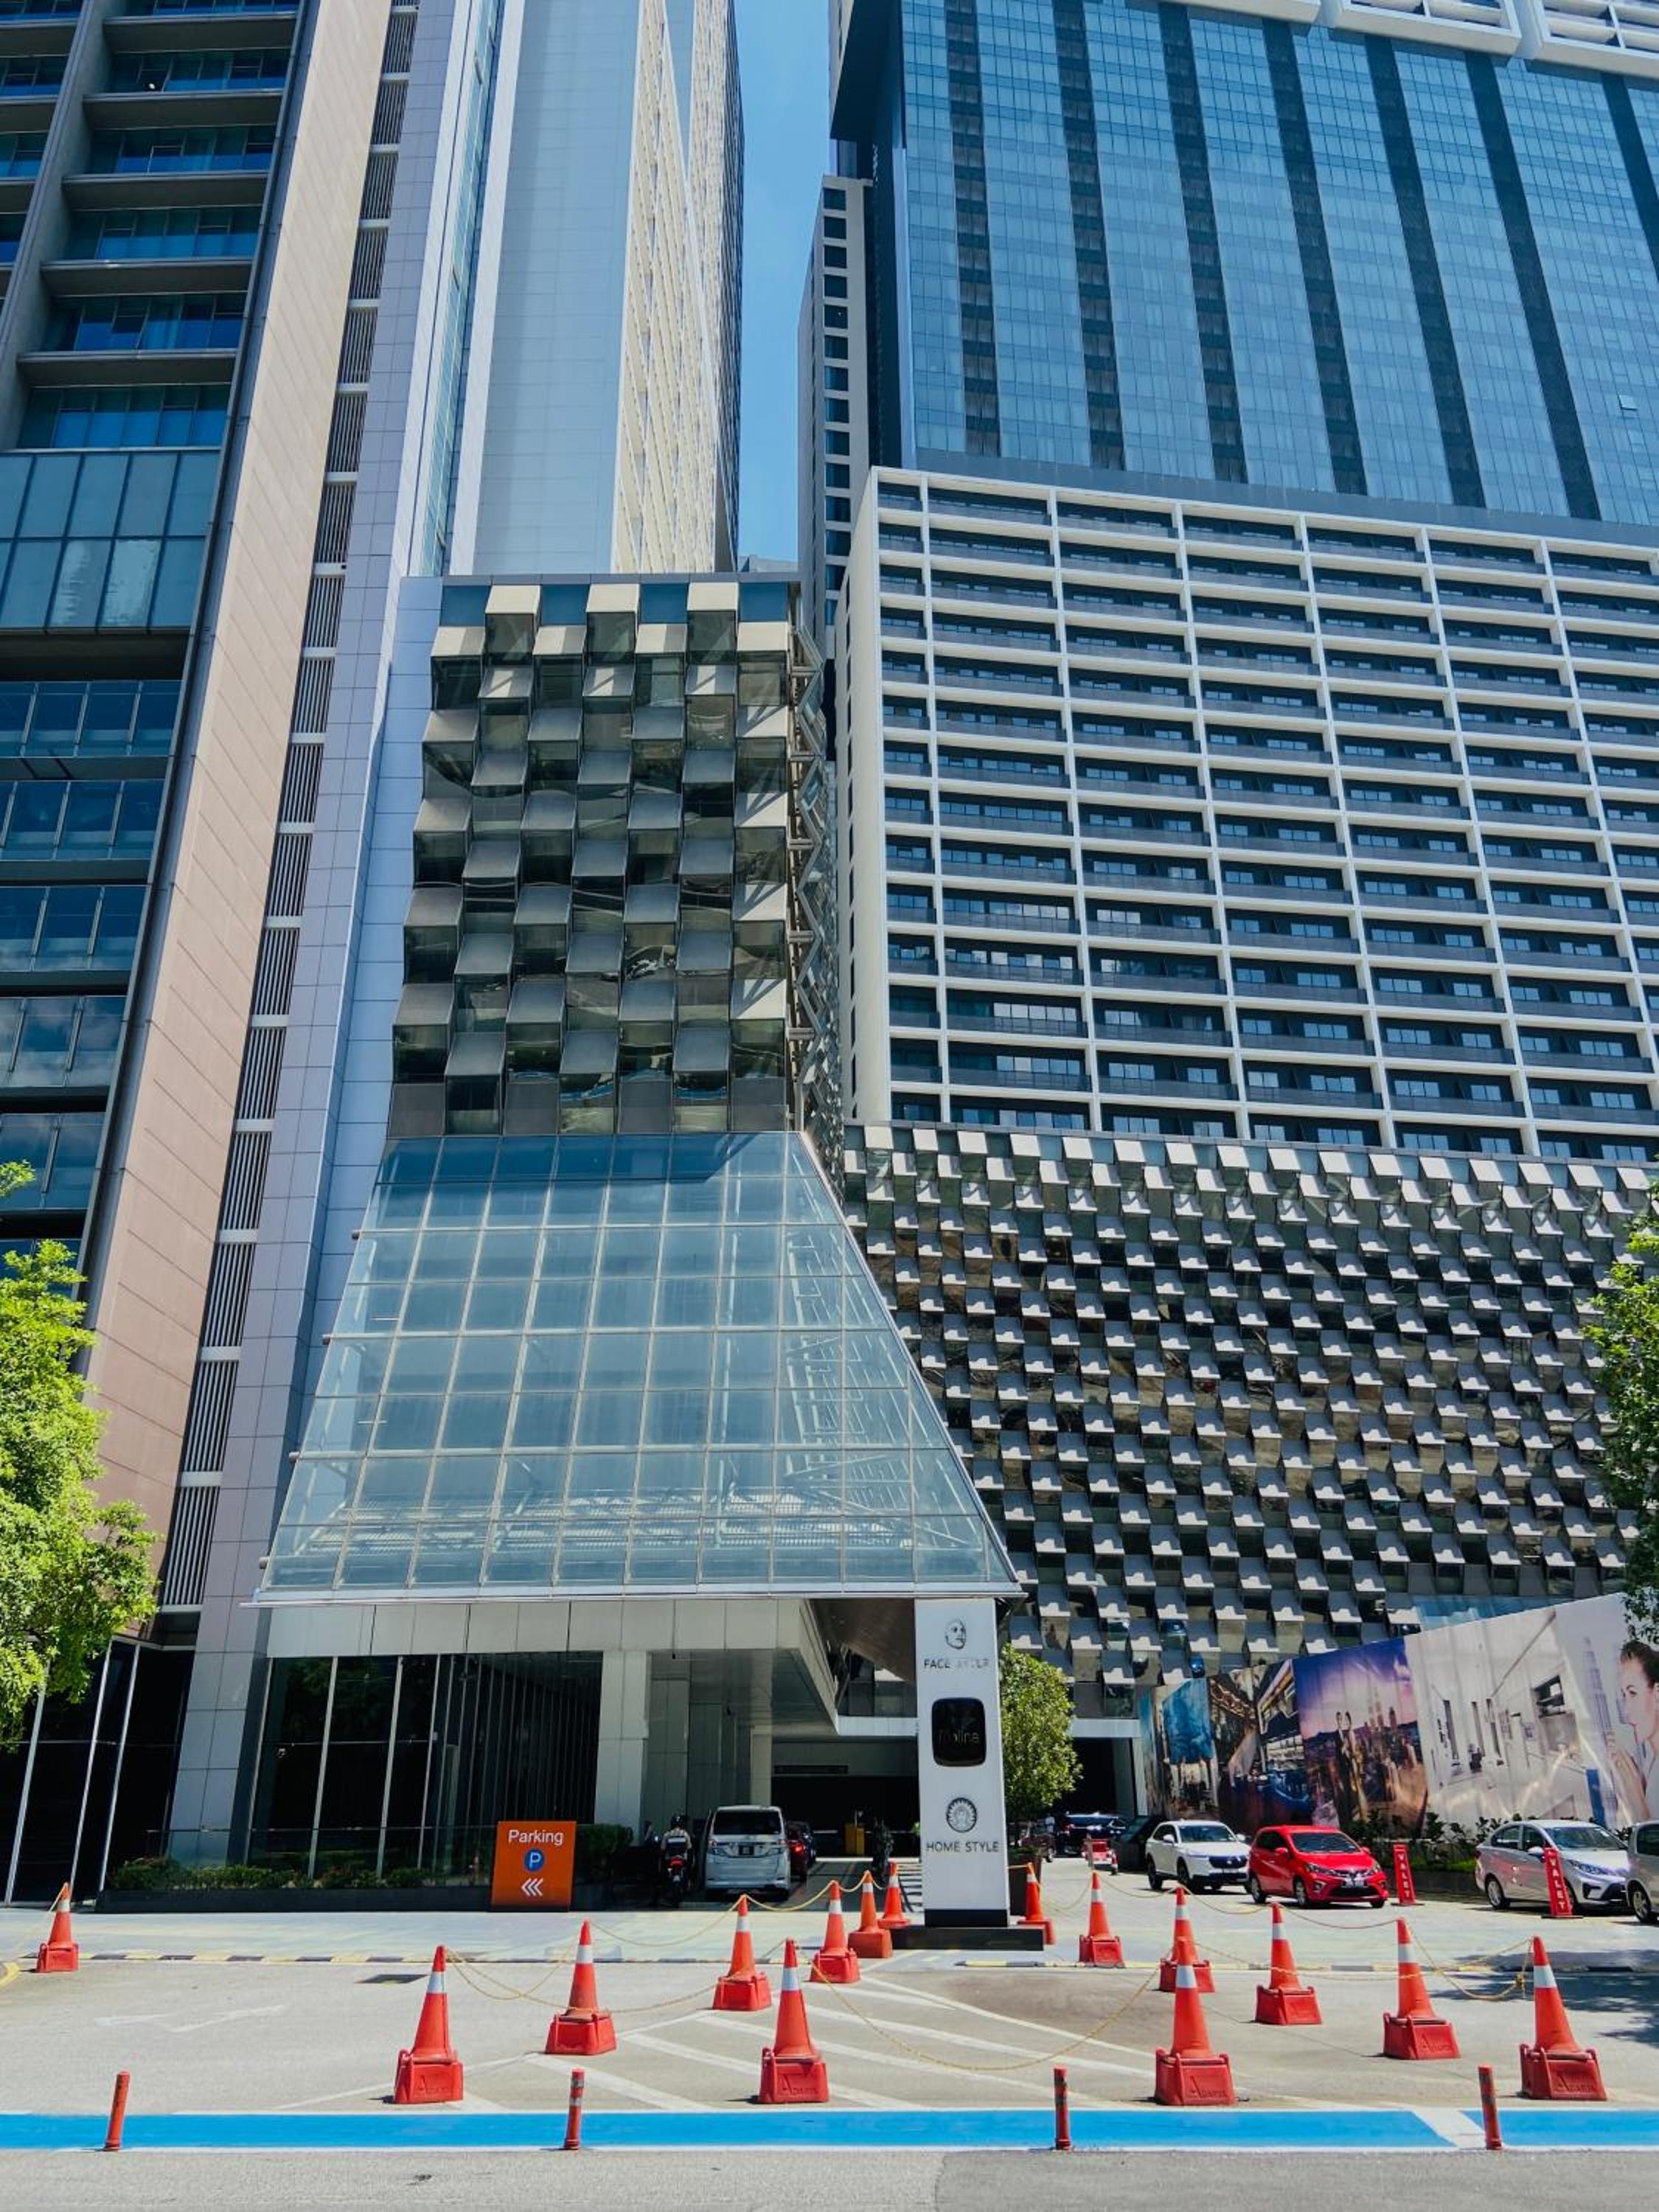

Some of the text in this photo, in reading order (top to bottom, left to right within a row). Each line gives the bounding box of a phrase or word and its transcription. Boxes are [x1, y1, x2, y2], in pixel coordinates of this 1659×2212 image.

[507, 1829, 564, 1846] Parking
[927, 1841, 999, 1853] HOME STYLE
[529, 1851, 542, 1869] P
[1397, 1853, 1411, 1898] VALET
[1549, 1858, 1565, 1910] VALET
